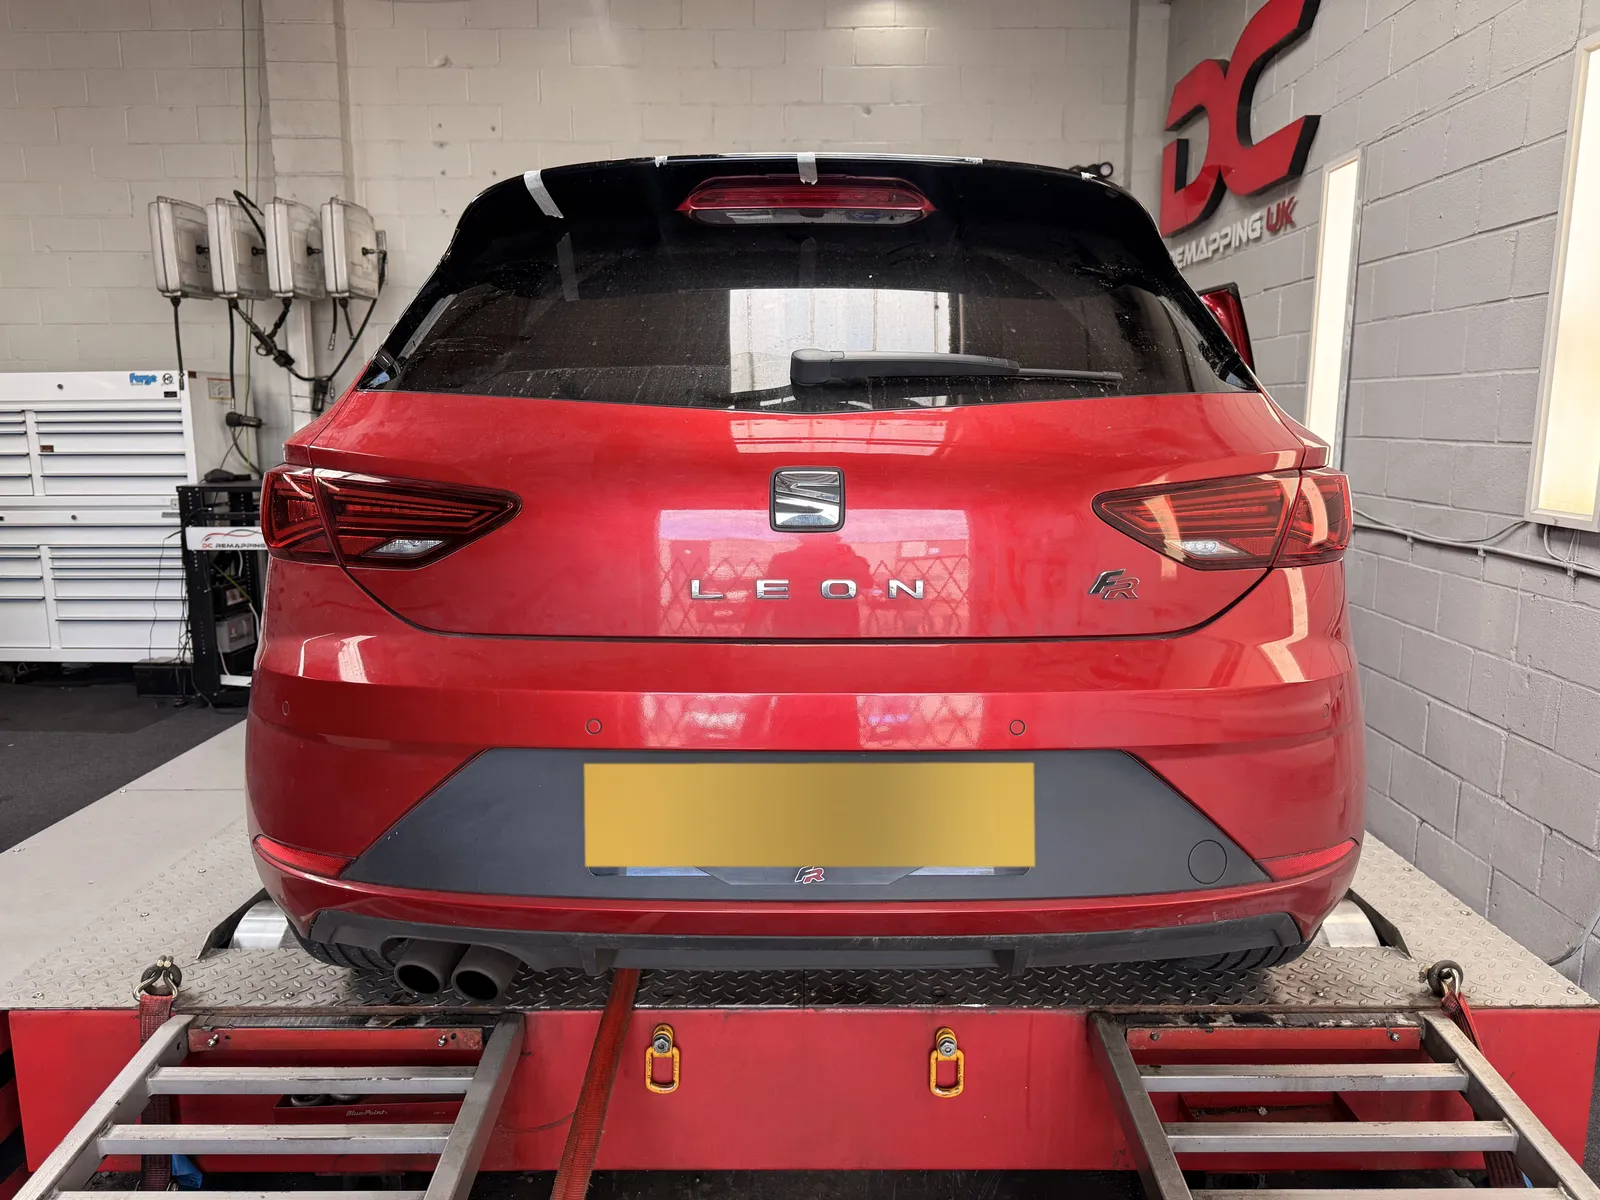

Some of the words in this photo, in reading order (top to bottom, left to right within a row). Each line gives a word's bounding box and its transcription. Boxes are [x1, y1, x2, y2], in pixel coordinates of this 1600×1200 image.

[1160, 0, 1321, 238] DC
[1266, 195, 1297, 232] UK
[690, 579, 925, 599] LEON
[1087, 568, 1140, 600] FR
[794, 866, 825, 885] FR
